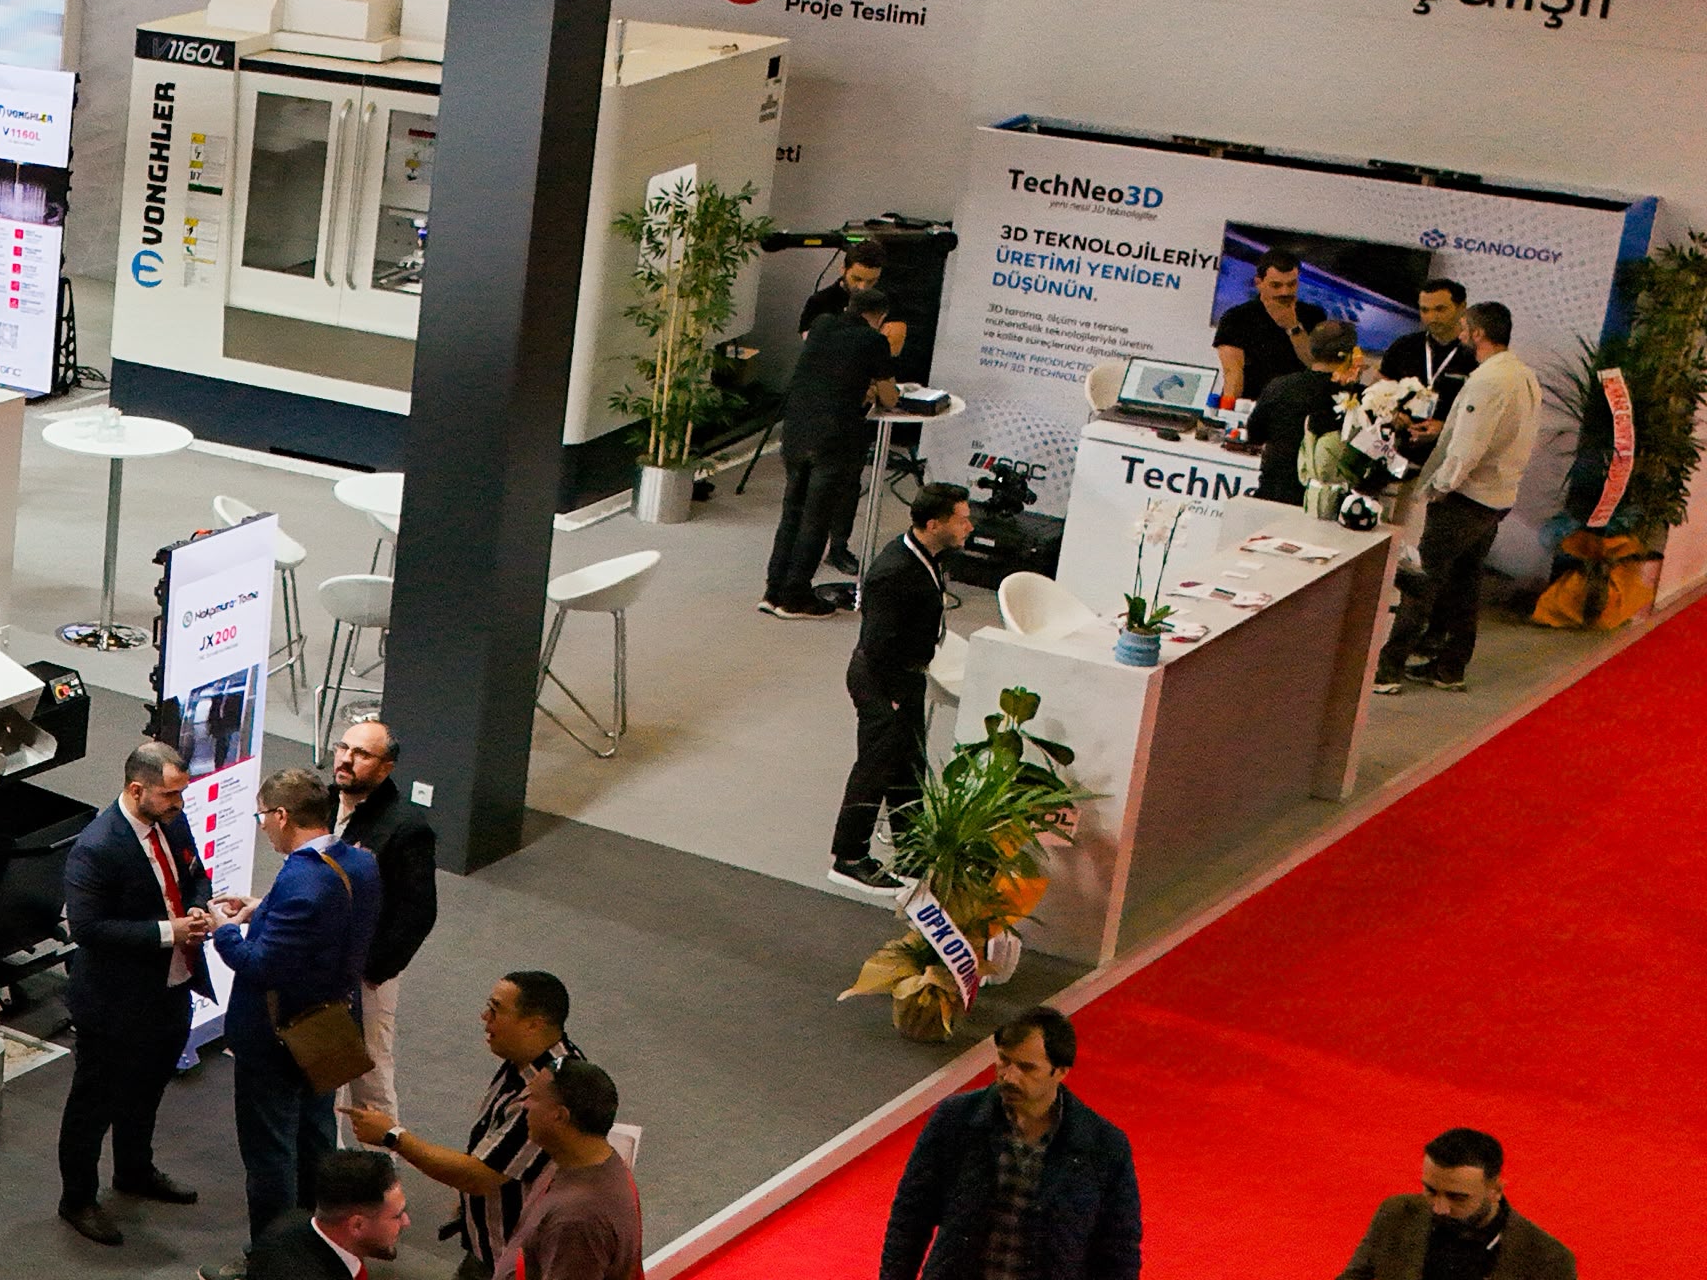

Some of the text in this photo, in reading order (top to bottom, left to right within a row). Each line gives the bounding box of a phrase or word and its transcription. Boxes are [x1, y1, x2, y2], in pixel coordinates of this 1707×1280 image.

[851, 0, 927, 26] Teslimi
[141, 81, 176, 246] VONGHLER
[776, 145, 801, 163] eti
[1008, 168, 1164, 209] TechNeo3D
[1000, 224, 1220, 271] 3D TEKNOLOJİLERİYL
[1453, 236, 1563, 264] SCANOLOGY
[996, 245, 1180, 289] ÜRETİMİ YENİDEN
[993, 271, 1098, 302] DÜŞÜNÜN.
[1028, 365, 1087, 384] TECHNOLO
[1029, 354, 1095, 373] PRODUCTIO
[199, 625, 237, 651] JX200
